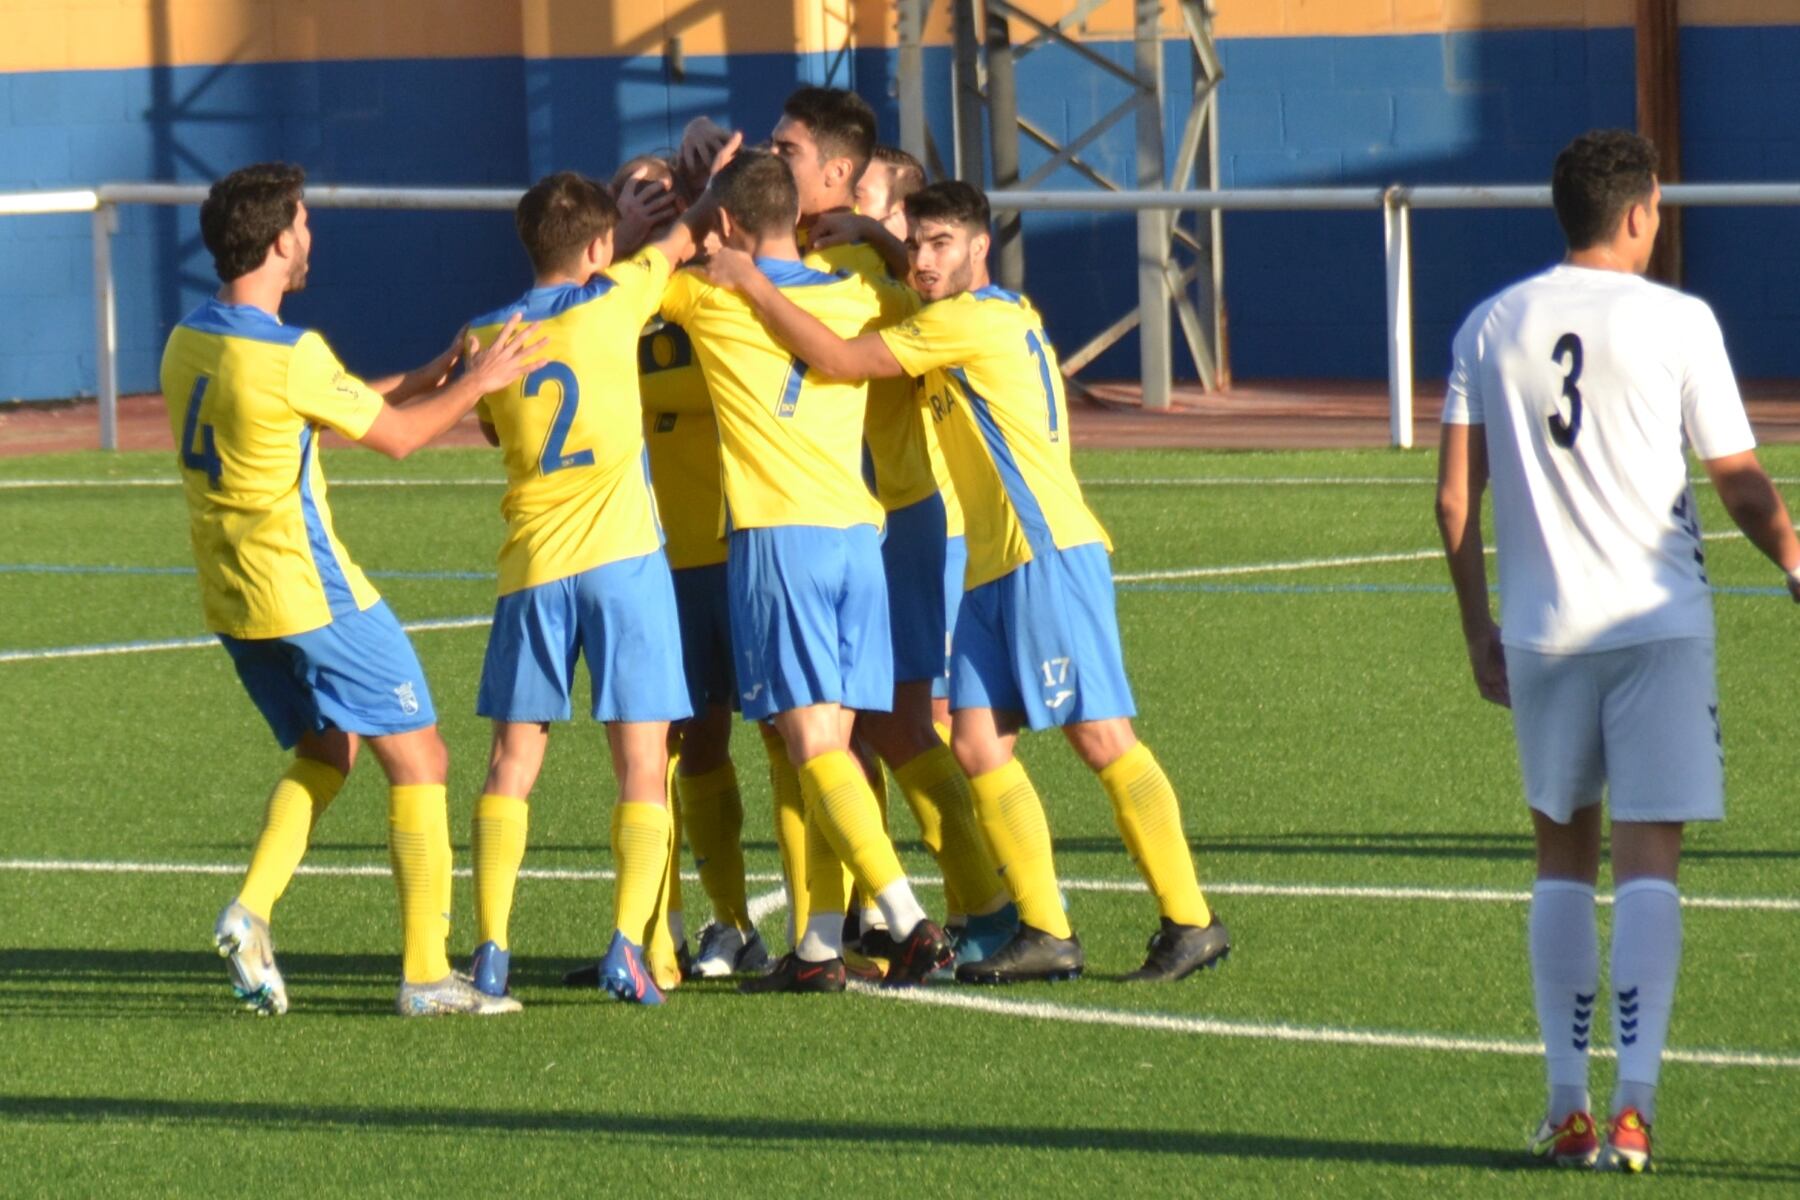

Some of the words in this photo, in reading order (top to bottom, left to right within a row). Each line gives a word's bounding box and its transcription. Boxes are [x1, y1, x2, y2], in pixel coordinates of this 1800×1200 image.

[181, 375, 223, 491] 4
[520, 361, 595, 476] 2
[1548, 333, 1582, 449] 3
[1043, 657, 1070, 686] 17
